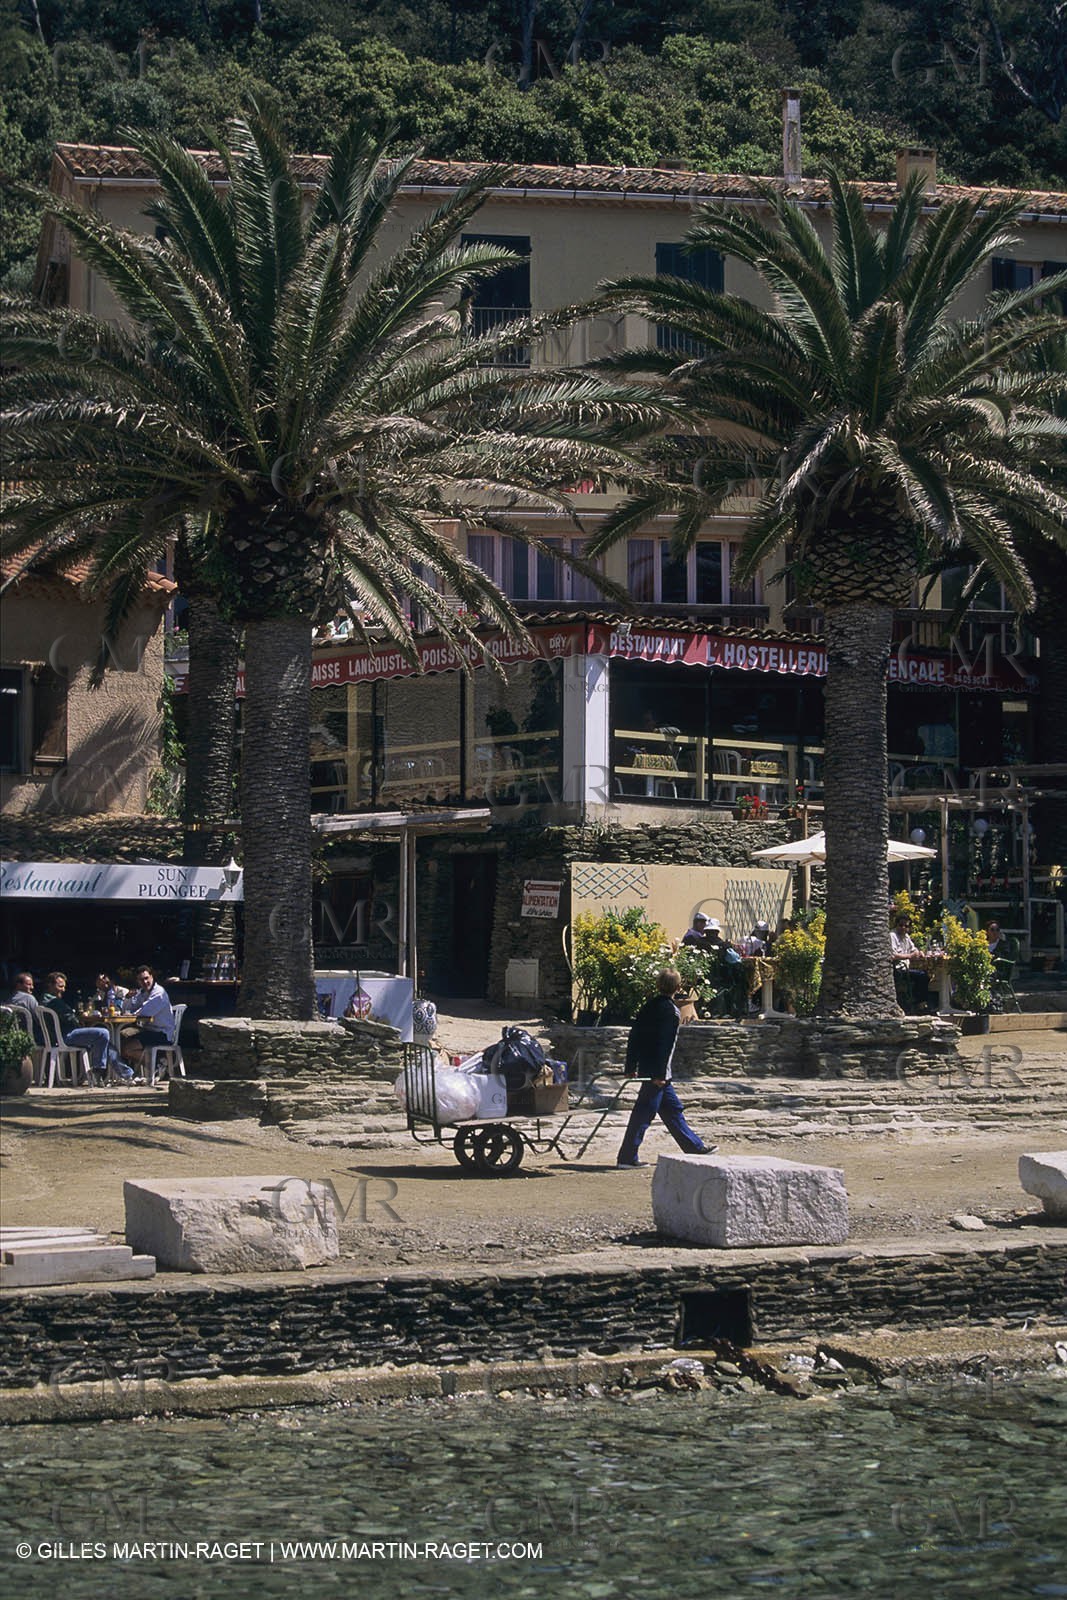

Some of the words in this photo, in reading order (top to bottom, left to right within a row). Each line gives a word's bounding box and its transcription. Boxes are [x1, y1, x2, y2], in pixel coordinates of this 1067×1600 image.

[549, 636, 567, 649] DRY
[422, 645, 478, 667] POISSNS
[609, 632, 686, 658] RESTAURANT
[889, 656, 945, 683] ENÇALE
[157, 868, 188, 882] SUN
[138, 883, 207, 897] PLONGEE
